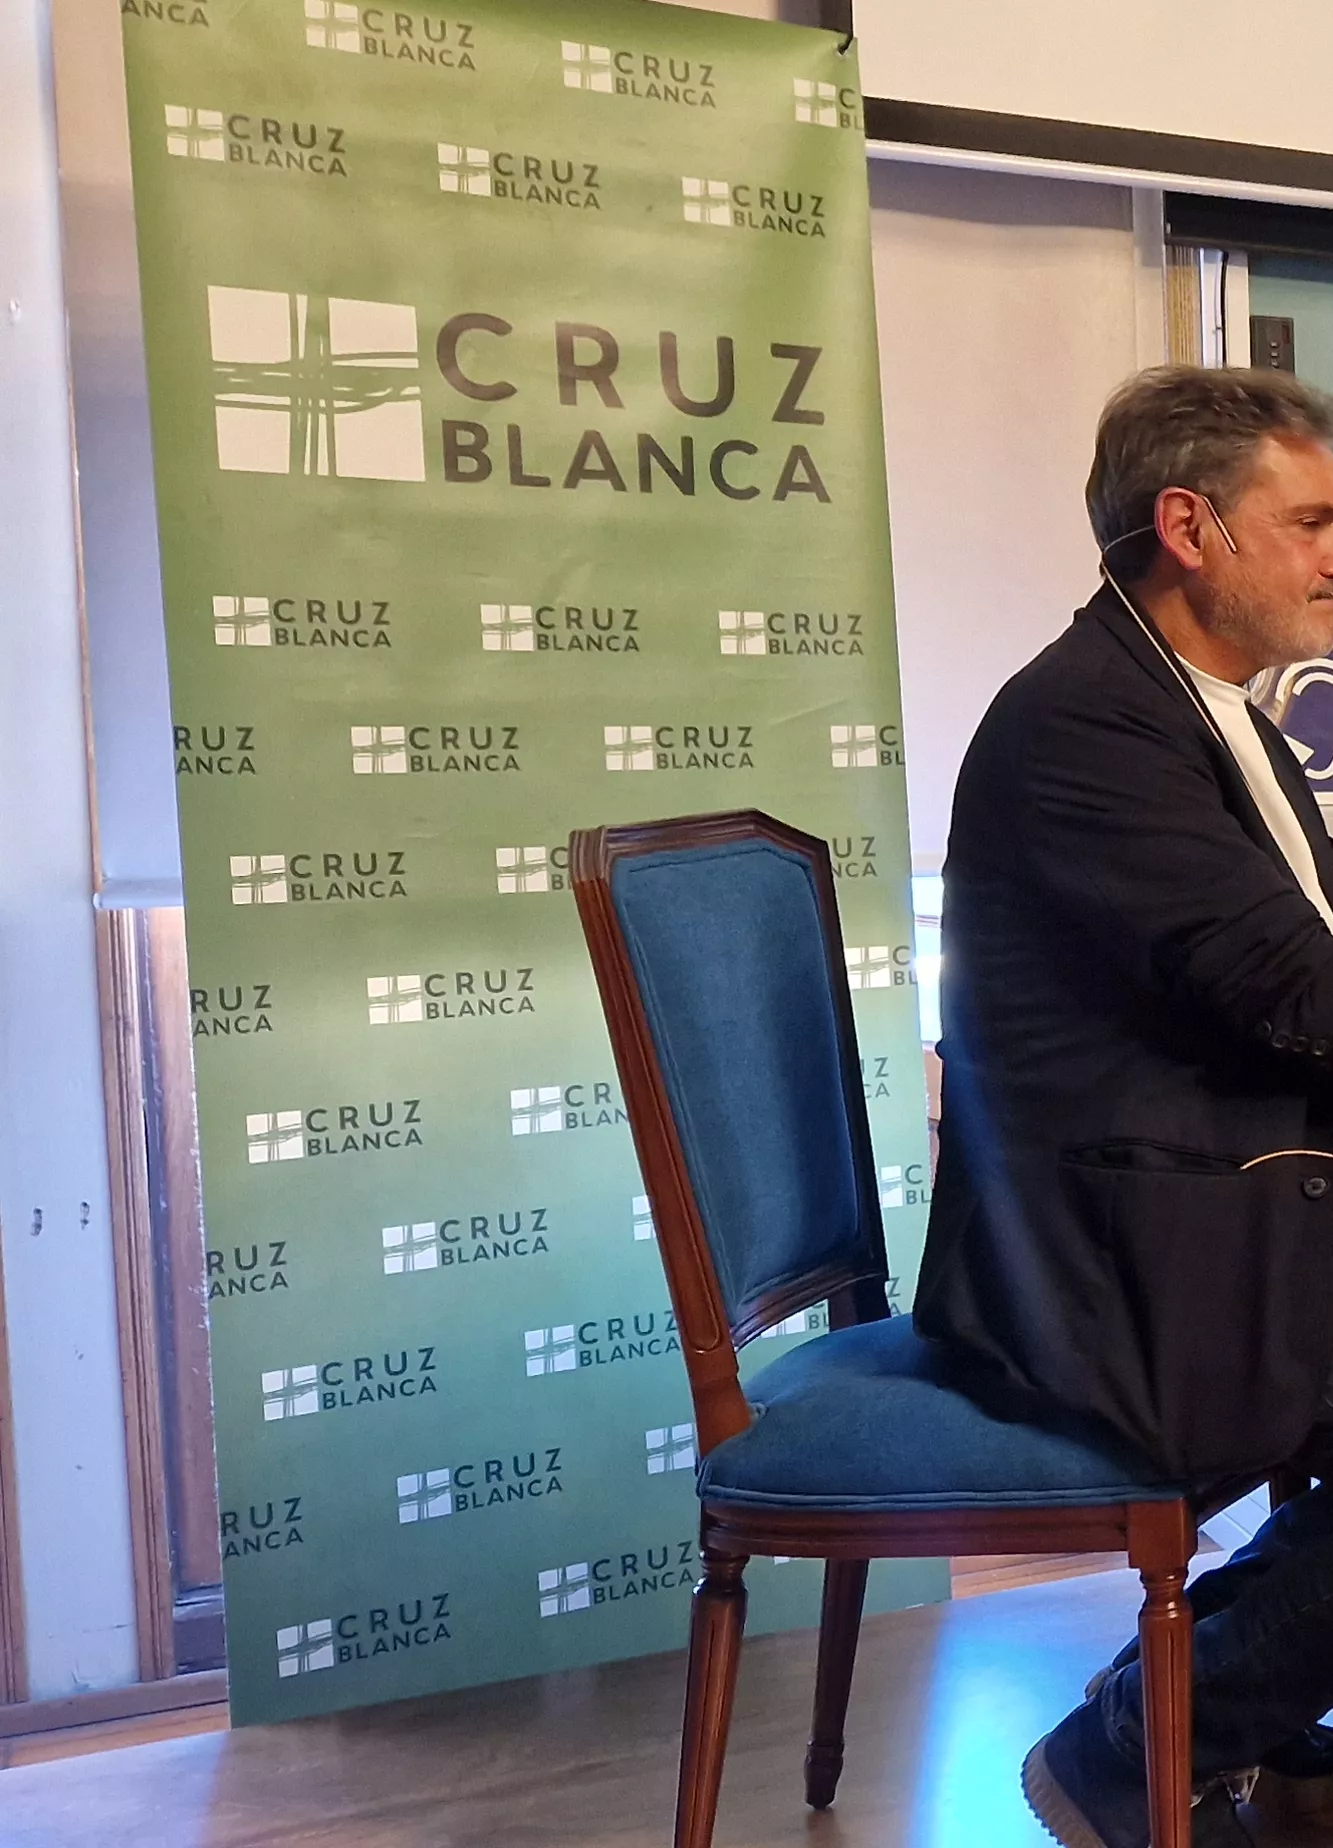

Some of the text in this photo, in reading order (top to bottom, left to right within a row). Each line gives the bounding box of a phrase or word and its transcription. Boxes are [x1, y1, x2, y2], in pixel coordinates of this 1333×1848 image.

[121, 0, 209, 28] ANCA
[362, 9, 475, 49] CRUZ
[364, 36, 476, 71] BLANCA
[614, 51, 715, 88] CRUZ
[615, 77, 716, 109] BLANCA
[227, 114, 346, 153] CRUZ
[229, 144, 348, 178] BLANCA
[493, 152, 600, 188] CRUZ
[494, 180, 601, 210] BLANCA
[732, 184, 825, 218] CRUZ
[734, 211, 826, 238] BLANCA
[436, 313, 827, 427] CRUZ
[442, 418, 833, 504] BLANCA
[273, 599, 391, 626] CRUZ
[535, 606, 639, 631] CRUZ
[767, 612, 863, 636] CRUZ
[275, 628, 392, 648] BLANCA
[536, 634, 640, 653] BLANCA
[769, 638, 864, 656] BLANCA
[173, 726, 255, 751] RUZ
[408, 726, 520, 751] CRUZ
[655, 725, 754, 749] CRUZ
[175, 756, 257, 776] ANCA
[410, 755, 521, 773] BLANCA
[656, 752, 755, 770] BLANCA
[289, 851, 407, 879] CRUZ
[292, 880, 408, 902] BLANCA
[191, 984, 273, 1014] RUZ
[424, 968, 534, 998] CRUZ
[427, 996, 535, 1021] BLANCA
[192, 1014, 274, 1038] ANCA
[305, 1099, 422, 1135] CRUZ
[565, 1107, 630, 1131] BLAN
[307, 1127, 423, 1158] BLANCA
[439, 1207, 549, 1245] CRUZ
[207, 1240, 288, 1277] RUZ
[441, 1235, 550, 1267] BLANCA
[208, 1271, 290, 1301] ANCA
[578, 1310, 677, 1345] CRUZ
[320, 1346, 438, 1387] CRUZ
[580, 1336, 681, 1368] BLANCA
[322, 1375, 438, 1411] BLANCA
[453, 1447, 563, 1489] CRUZ
[455, 1476, 563, 1513] BLANCA
[221, 1496, 303, 1537] RUZ
[222, 1526, 304, 1560] ANCA
[592, 1541, 693, 1582] CRUZ
[593, 1570, 694, 1605] BLANCA
[338, 1593, 451, 1640] CRUZ
[339, 1622, 452, 1664] BLANCA
